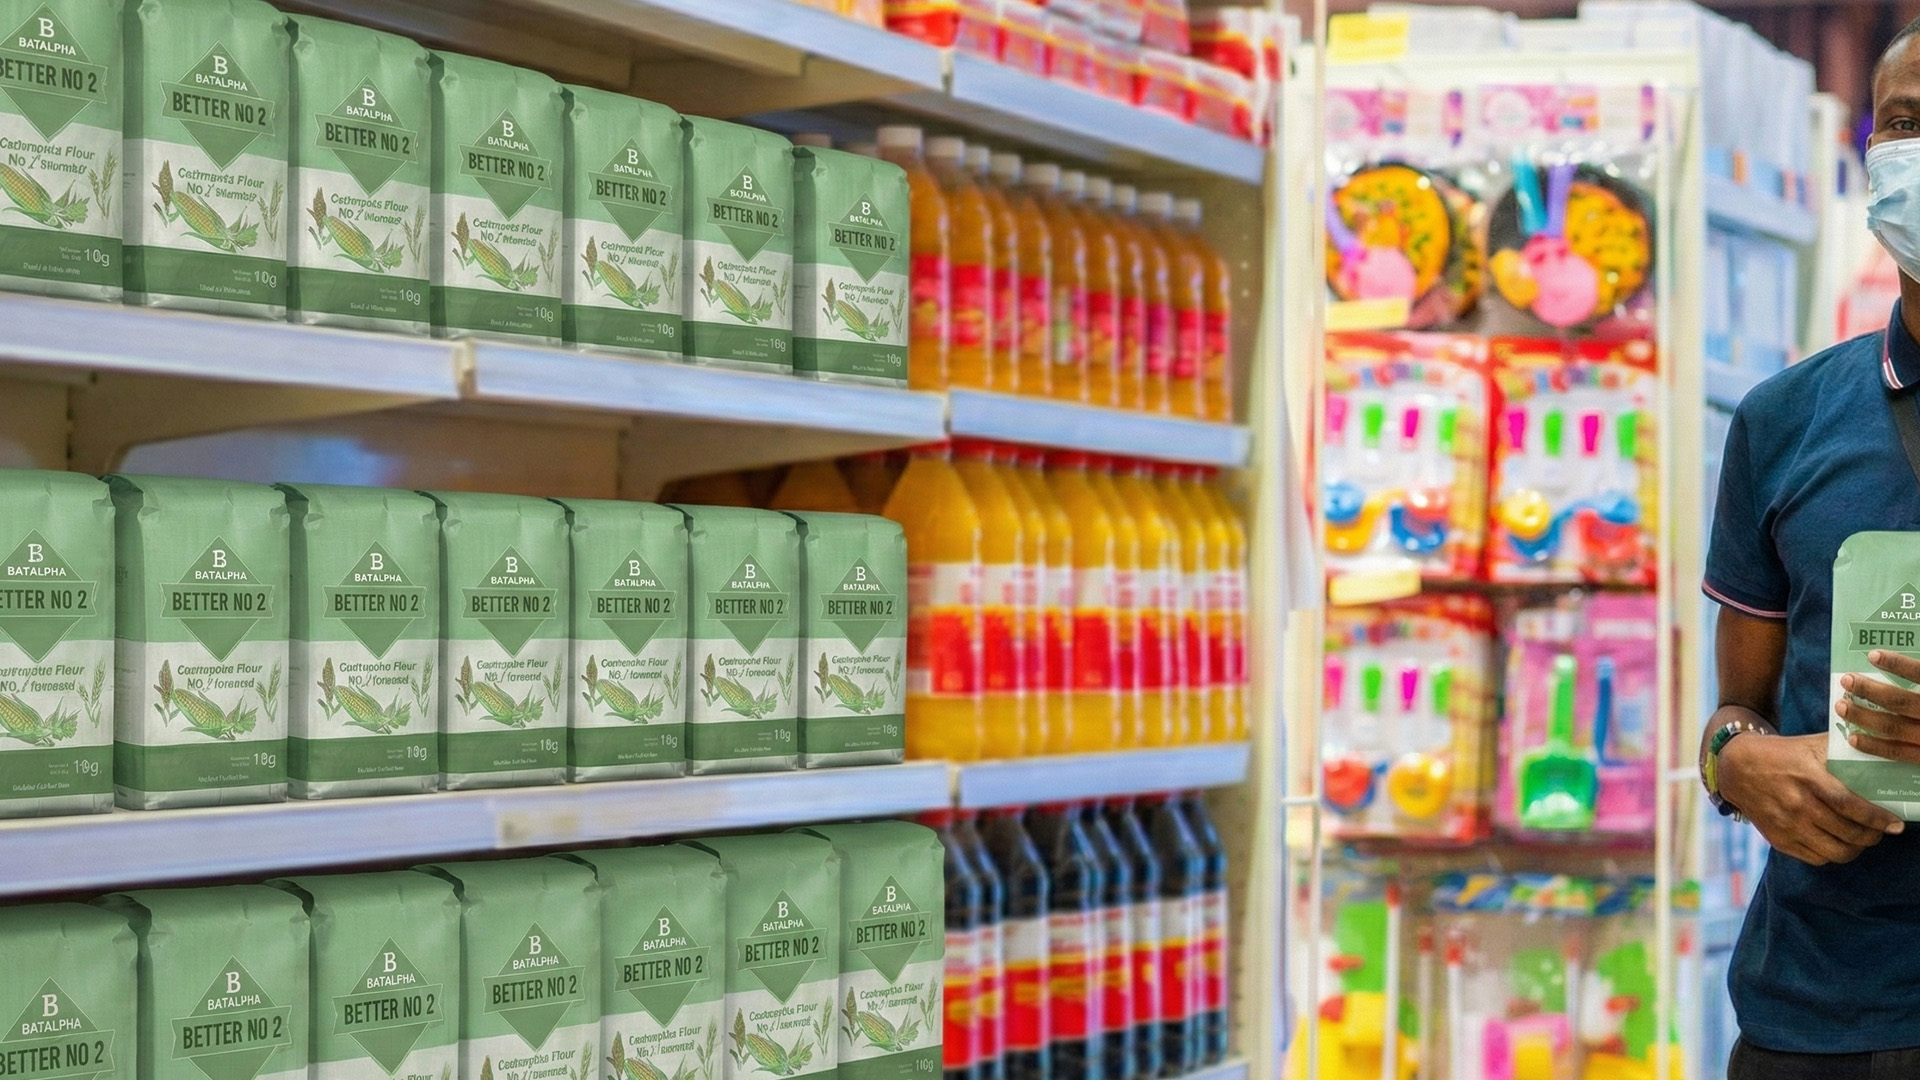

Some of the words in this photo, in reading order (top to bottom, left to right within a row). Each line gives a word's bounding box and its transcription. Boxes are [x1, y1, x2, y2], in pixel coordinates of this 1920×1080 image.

[38, 17, 54, 37] B
[19, 37, 76, 55] BATALPHA
[213, 55, 228, 74] B
[62, 68, 82, 90] NO
[88, 72, 97, 93] 2
[362, 88, 375, 107] B
[173, 91, 230, 120] BETTER
[235, 103, 253, 124] NO
[258, 108, 266, 125] 2
[347, 106, 393, 122] BATALPHA
[502, 120, 514, 137] B
[326, 122, 377, 149] BETTER
[381, 133, 398, 152] NO
[403, 137, 410, 154] 2
[627, 149, 638, 165] B
[469, 152, 515, 176] BETTER
[519, 161, 534, 179] NO
[538, 165, 544, 180] 2
[743, 175, 752, 190] B
[596, 179, 639, 201] BETTER
[642, 187, 656, 205] NO
[660, 191, 666, 206] 2
[714, 203, 753, 223] BETTER
[756, 211, 769, 226] NO
[772, 214, 778, 227] 2
[835, 229, 872, 247] BETTER
[890, 238, 895, 251] 2
[84, 249, 110, 267] 10g
[255, 271, 276, 287] 10g
[657, 323, 674, 337] 10g
[28, 544, 43, 563] B
[212, 549, 226, 568] B
[370, 553, 383, 570] B
[8, 566, 66, 576] BATALPHA
[506, 557, 518, 573] B
[629, 560, 640, 576] B
[745, 564, 755, 578] B
[195, 571, 247, 580] BATALPHA
[355, 573, 402, 582] BATALPHA
[491, 576, 535, 585] BATALPHA
[856, 567, 866, 581] B
[51, 590, 72, 609] NO
[78, 590, 87, 609] 2
[173, 592, 228, 611] BETTER
[234, 593, 252, 611] NO
[257, 593, 266, 611] 2
[335, 594, 385, 611] BETTER
[390, 594, 406, 611] NO
[411, 594, 418, 611] 2
[472, 596, 519, 612] BETTER
[523, 597, 539, 612] NO
[543, 596, 550, 612] 2
[598, 597, 641, 613] BETTER
[645, 598, 660, 613] NO
[664, 598, 670, 613] 2
[716, 599, 756, 614] BETTER
[760, 600, 773, 614] NO
[777, 600, 783, 614] 2
[828, 600, 866, 615] BETTER
[870, 601, 883, 615] NO
[886, 600, 892, 615] 2
[1901, 593, 1915, 608] B
[1859, 629, 1914, 646] BETTER
[885, 886, 896, 902] B
[778, 901, 788, 918] B
[658, 917, 670, 936] B
[763, 919, 803, 932] BATALPHA
[857, 924, 897, 944] BETTER
[901, 921, 915, 938] NO
[919, 920, 925, 936] 2
[528, 935, 541, 954] B
[644, 937, 686, 950] BATALPHA
[746, 940, 789, 962] BETTER
[793, 937, 808, 957] NO
[813, 936, 819, 953] 2
[383, 952, 396, 972] B
[513, 956, 559, 969] BATALPHA
[624, 959, 671, 983] BETTER
[675, 957, 691, 977] NO
[696, 955, 702, 973] 2
[226, 972, 241, 993] B
[493, 979, 543, 1004] BETTER
[548, 976, 564, 997] NO
[569, 975, 576, 994] 2
[42, 994, 59, 1017] B
[208, 995, 261, 1010] BATALPHA
[345, 999, 398, 1025] BETTER
[403, 996, 421, 1017] NO
[427, 994, 435, 1014] 2
[22, 1018, 81, 1034] BATALPHA
[183, 1021, 242, 1049] BETTER
[248, 1018, 268, 1041] NO
[273, 1016, 282, 1038] 2
[67, 1043, 88, 1067] NO
[95, 1040, 104, 1064] 2
